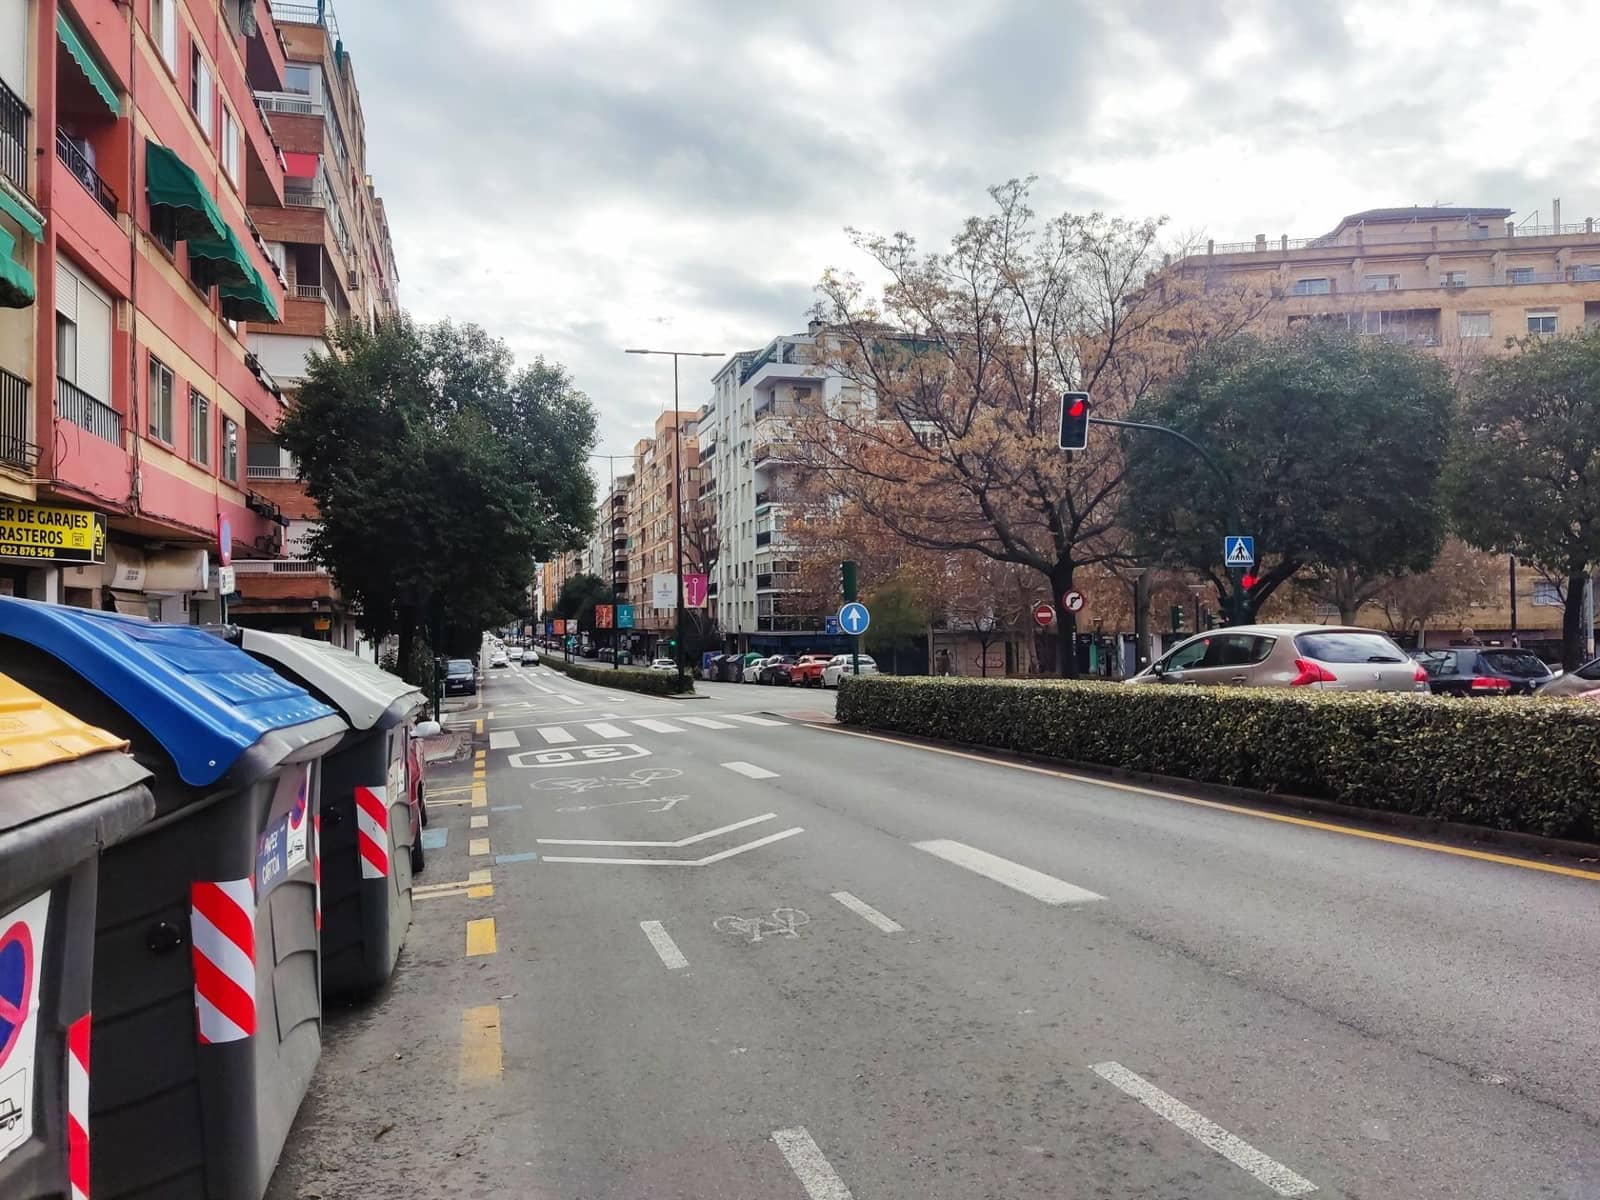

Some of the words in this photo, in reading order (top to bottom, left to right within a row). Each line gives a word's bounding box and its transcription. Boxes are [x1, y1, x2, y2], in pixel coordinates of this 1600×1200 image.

[18, 509, 34, 523] DE
[38, 511, 88, 529] GARAJES
[0, 526, 63, 544] RASTEROS
[0, 545, 18, 555] 622
[37, 547, 55, 558] 546
[536, 748, 622, 762] 30
